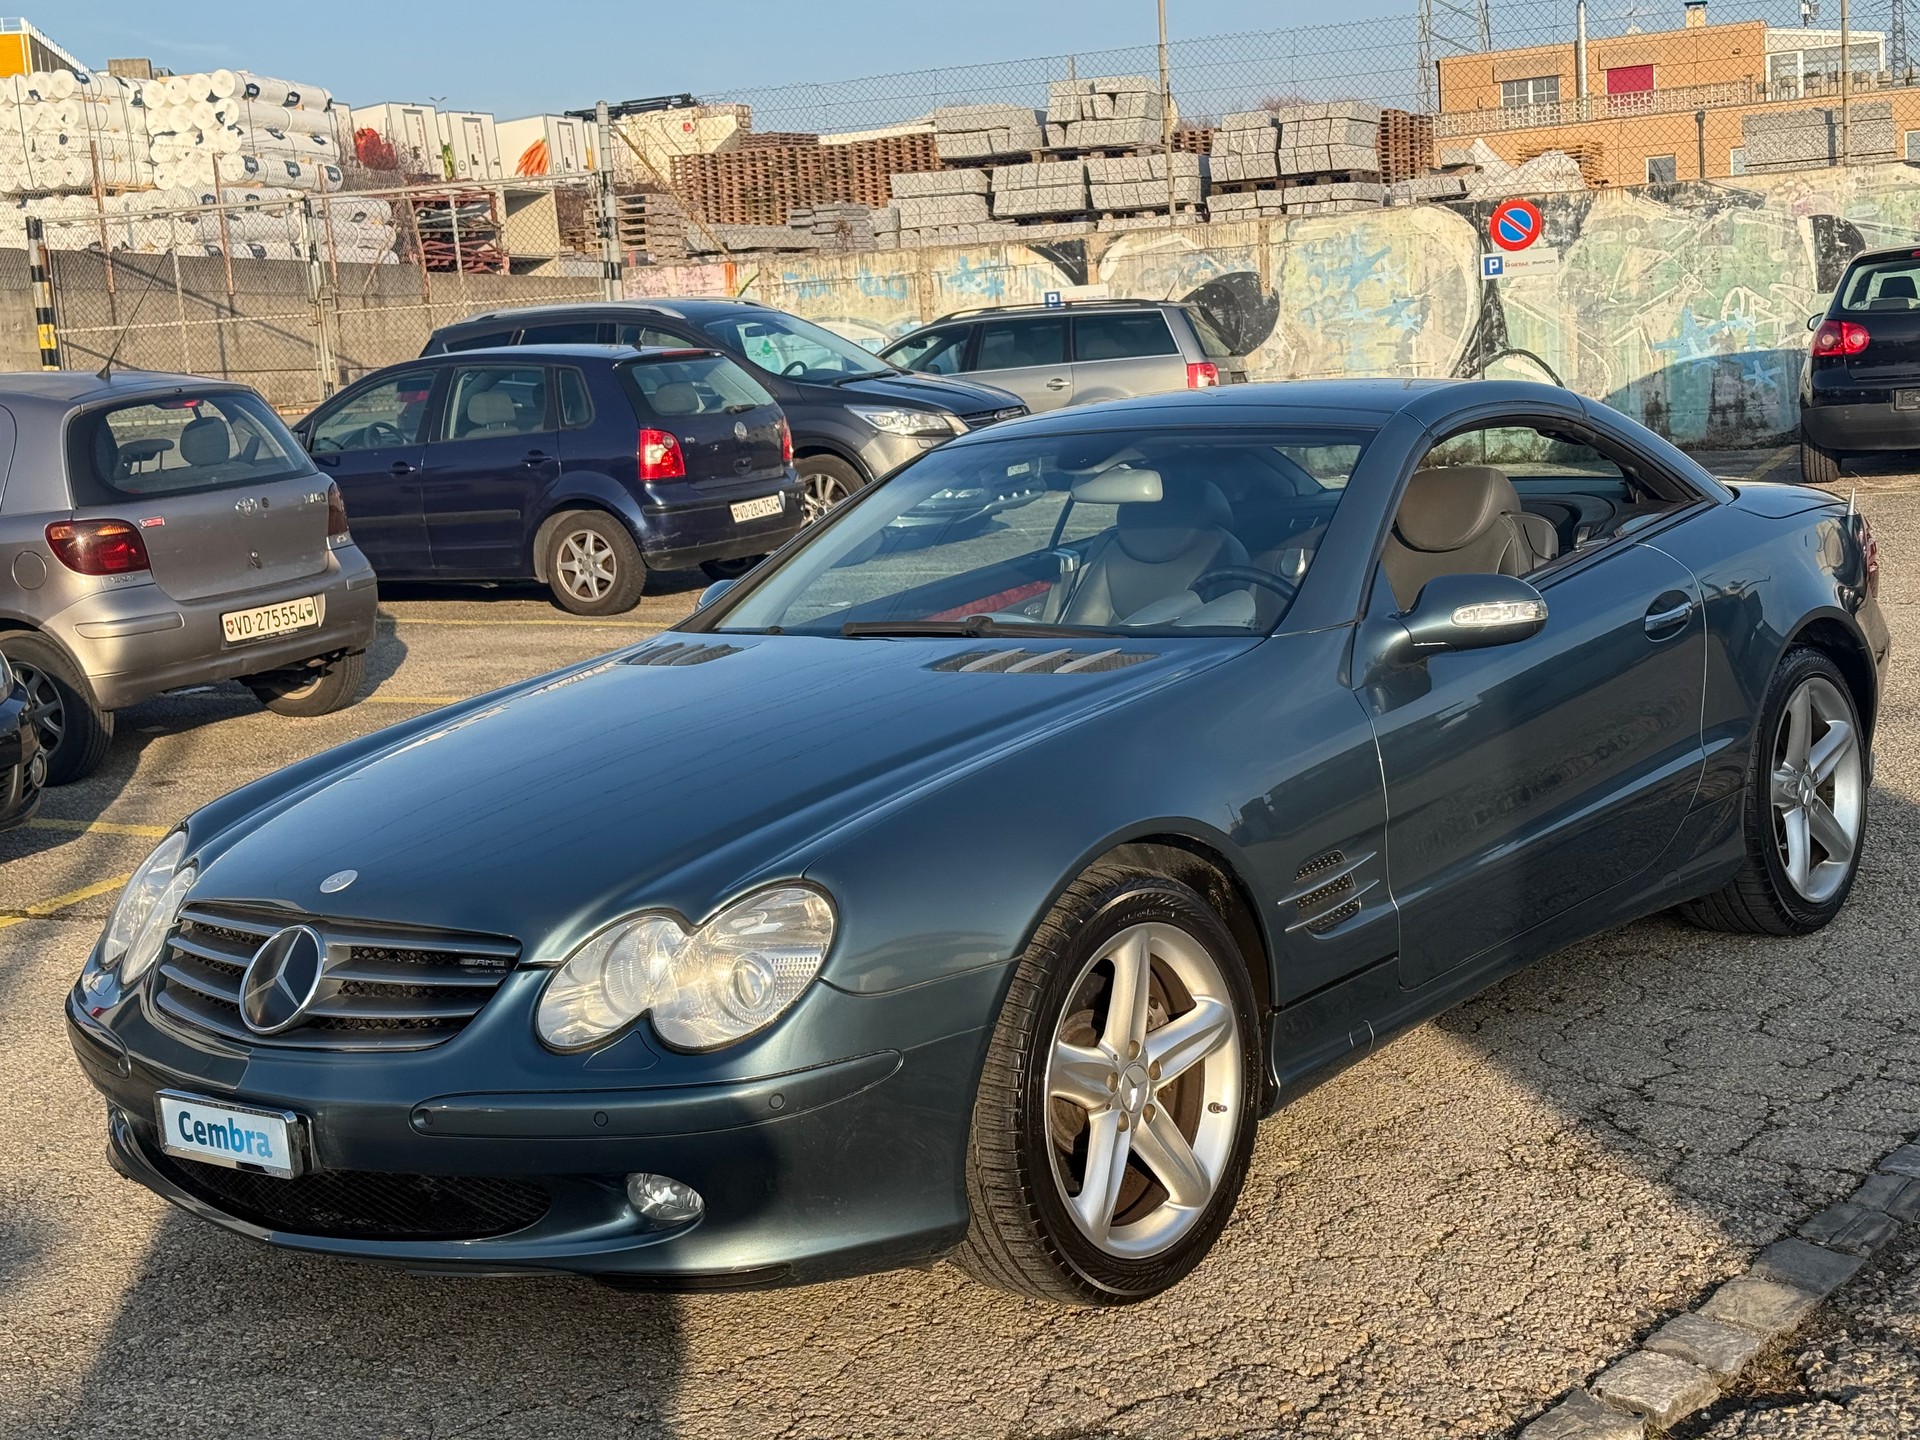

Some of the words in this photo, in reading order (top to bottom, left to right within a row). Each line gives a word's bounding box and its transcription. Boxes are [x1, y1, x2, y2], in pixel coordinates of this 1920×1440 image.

[1489, 258, 1499, 274] P
[475, 959, 505, 967] AMG
[178, 1110, 273, 1159] Cembra
